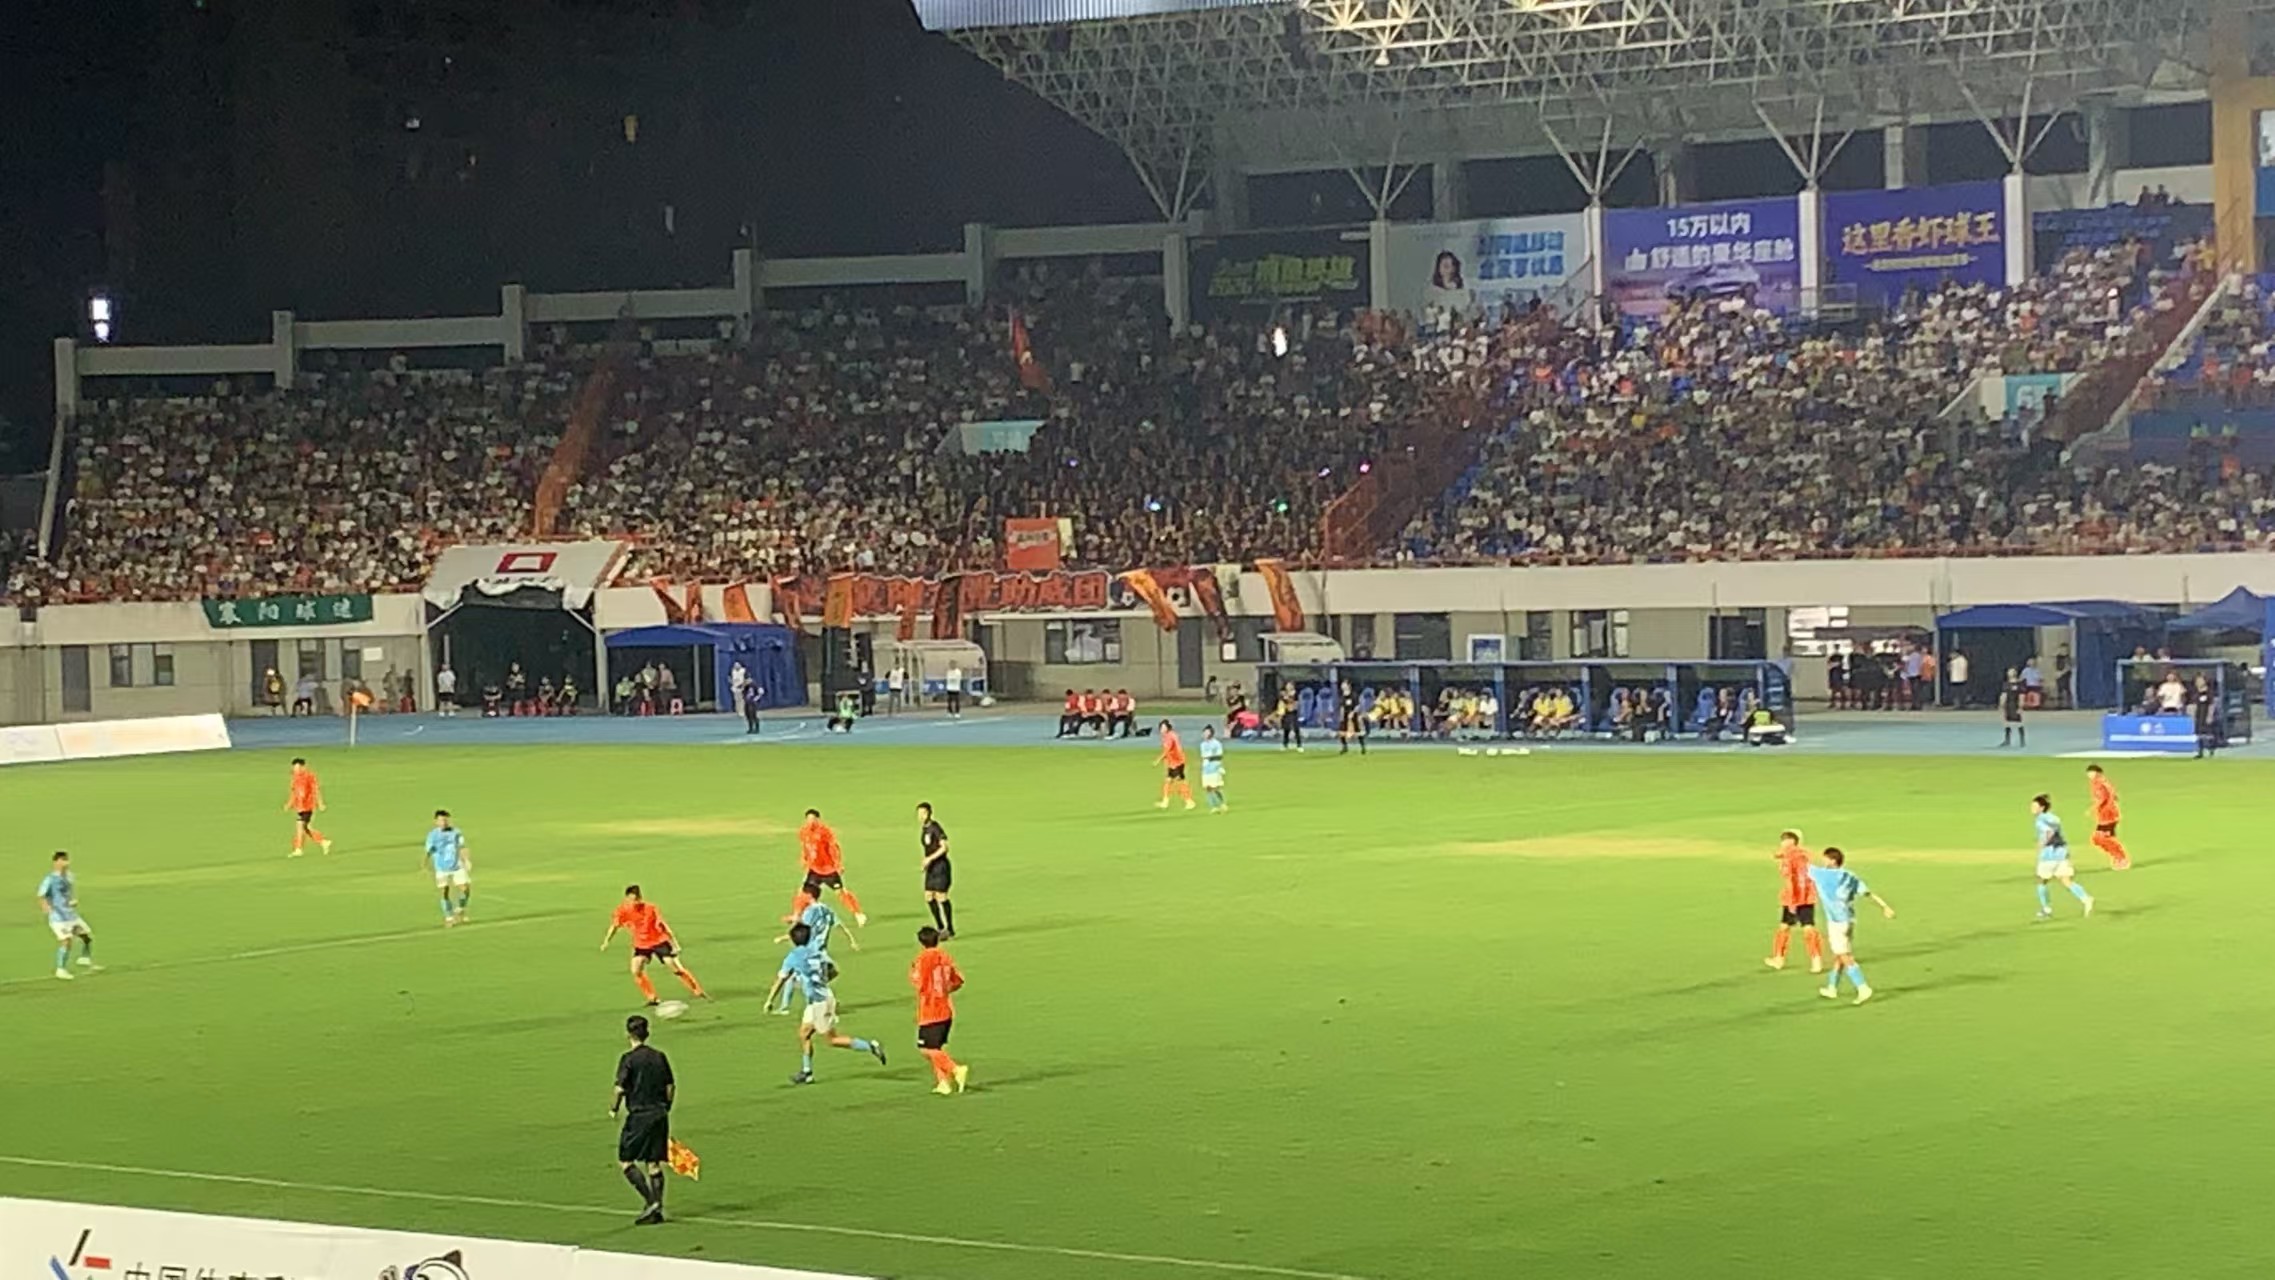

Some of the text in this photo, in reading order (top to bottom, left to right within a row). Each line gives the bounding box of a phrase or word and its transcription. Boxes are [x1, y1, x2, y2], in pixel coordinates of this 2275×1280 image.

[1667, 212, 1751, 238] 15万以内
[1842, 212, 2000, 256] 这里香虾球王
[218, 597, 354, 625] 襄阳球迷
